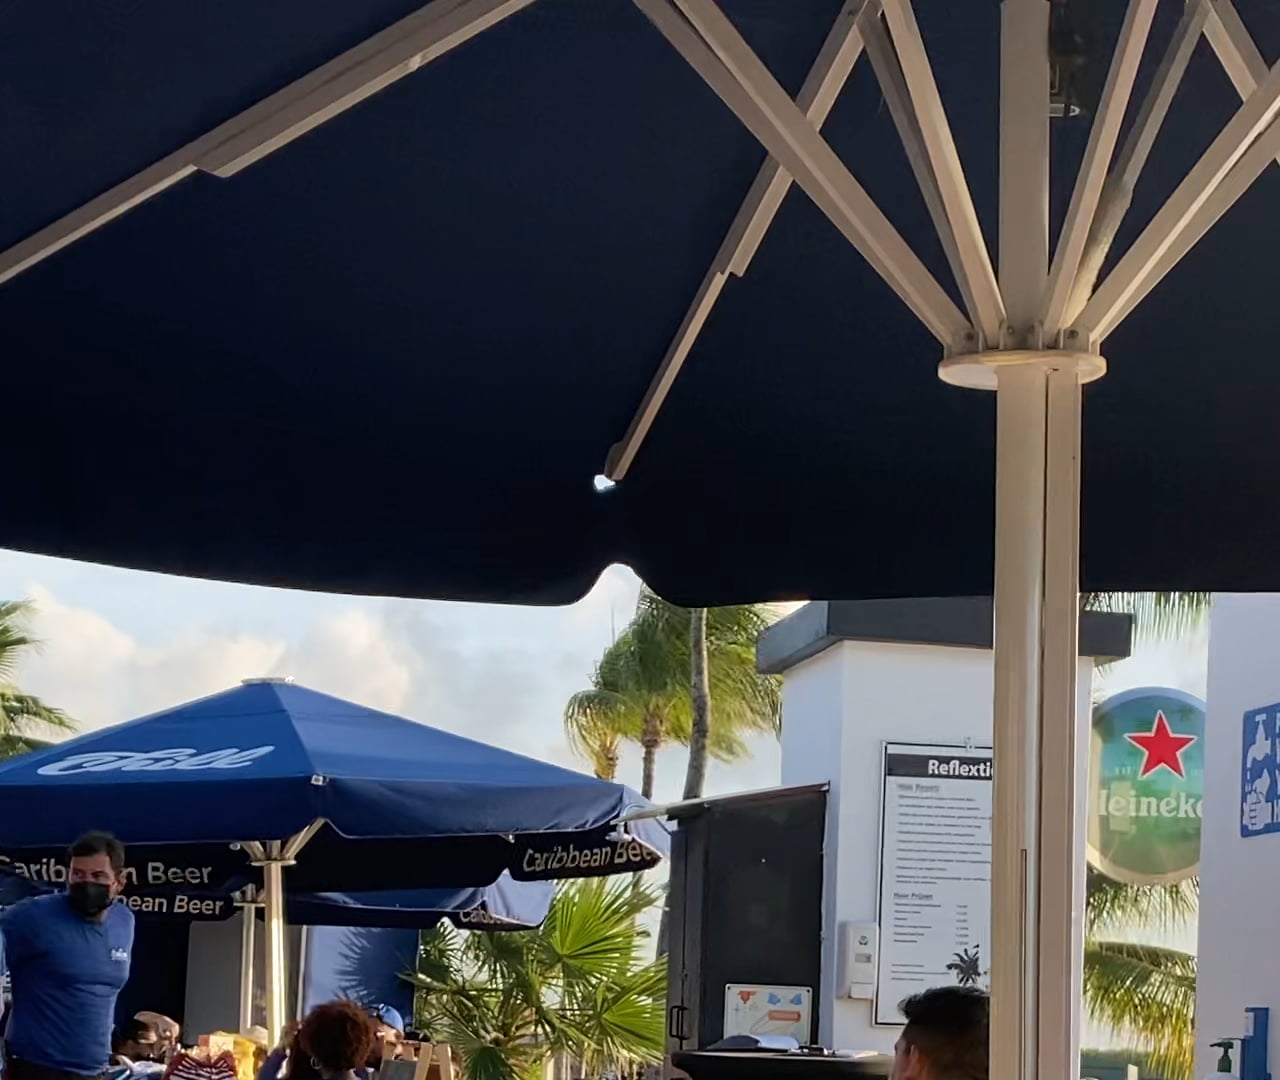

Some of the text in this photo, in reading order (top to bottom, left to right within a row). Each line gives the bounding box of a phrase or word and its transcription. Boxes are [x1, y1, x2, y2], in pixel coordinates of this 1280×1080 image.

[37, 745, 275, 775] Chill
[928, 759, 993, 777] Reflexti
[522, 840, 654, 873] Caribbean Bee
[147, 861, 213, 885] Beer
[173, 895, 224, 915] Beer
